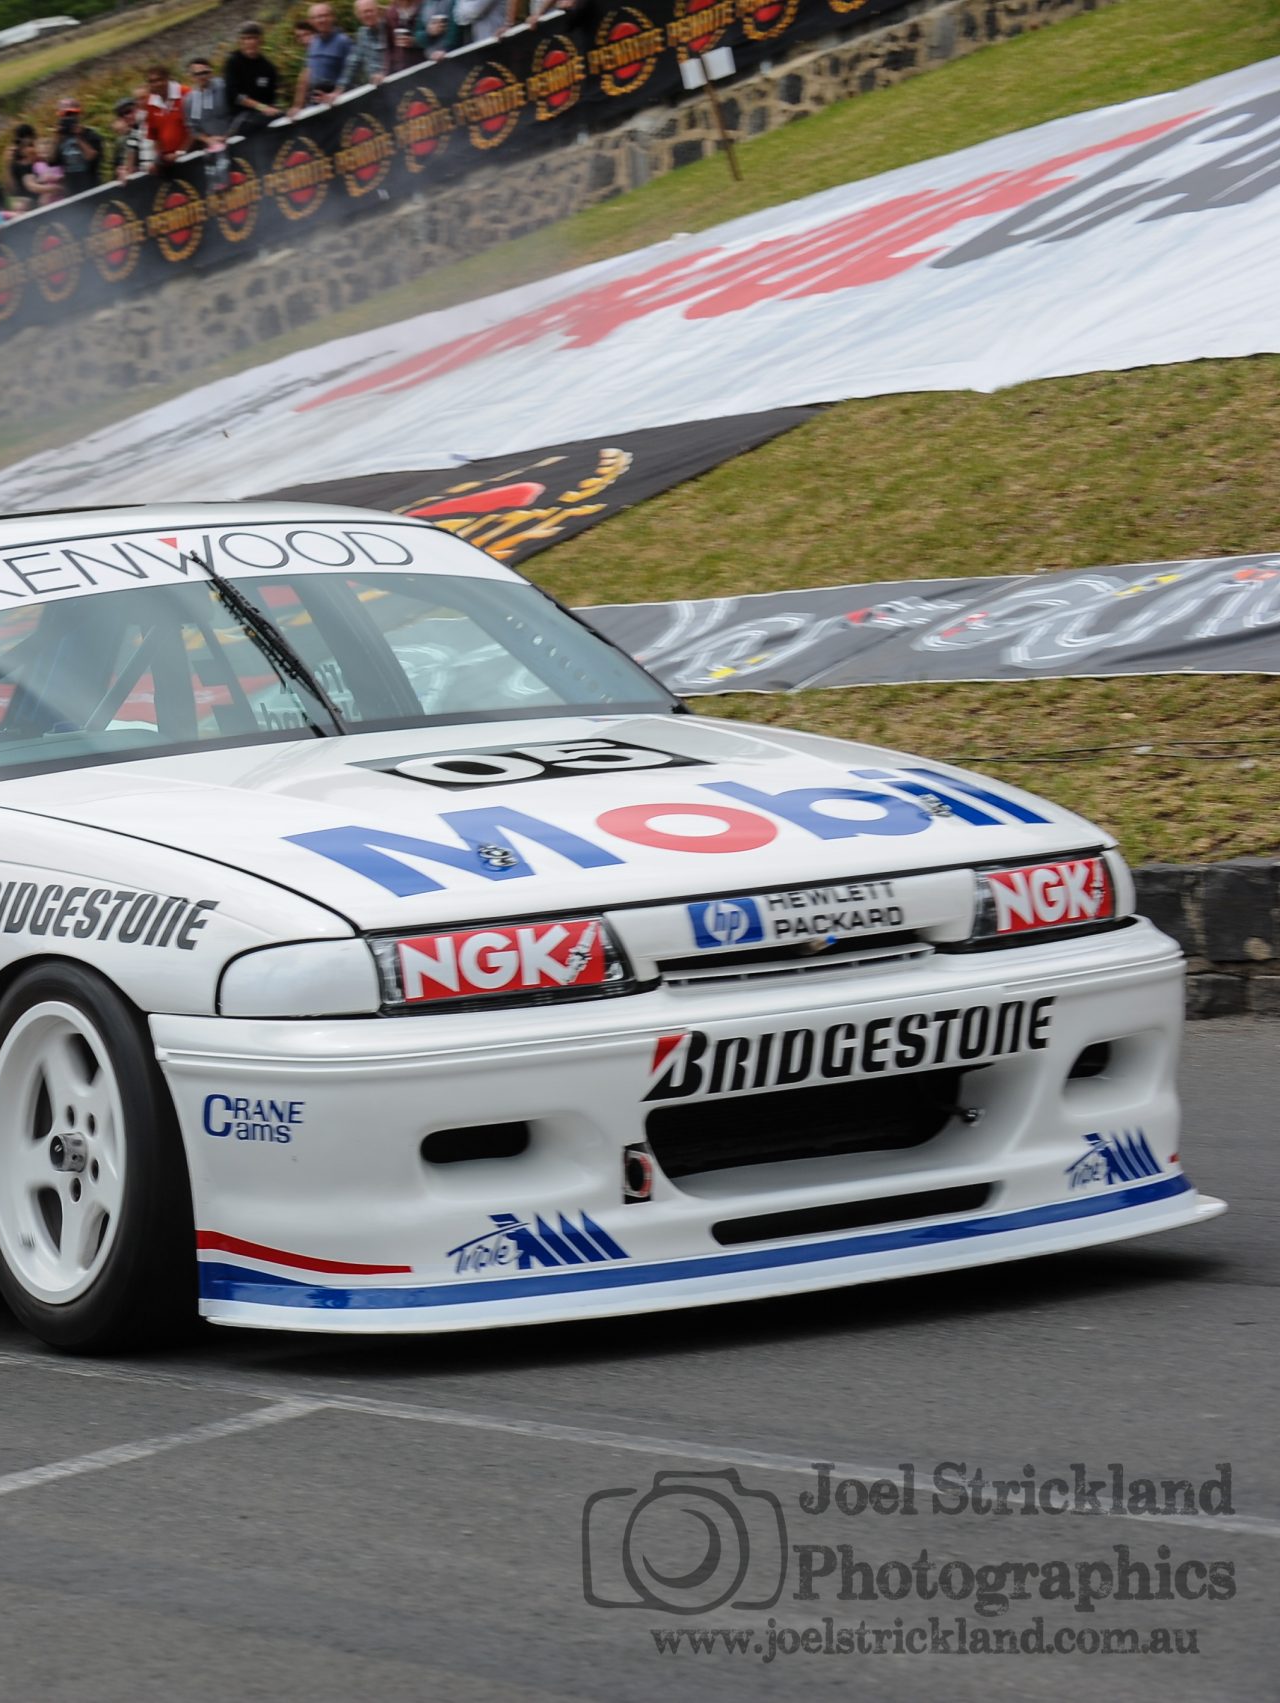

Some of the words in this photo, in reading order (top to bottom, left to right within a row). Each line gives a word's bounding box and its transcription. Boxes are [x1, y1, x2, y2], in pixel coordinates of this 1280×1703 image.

[396, 739, 674, 784] 05
[282, 767, 1055, 898] Mobil
[766, 881, 896, 911] HEWLETT
[773, 906, 904, 939] PACKARD
[989, 862, 1100, 932] NGK
[397, 921, 575, 1001] NGK
[639, 996, 1058, 1102] BRIDGESTONE
